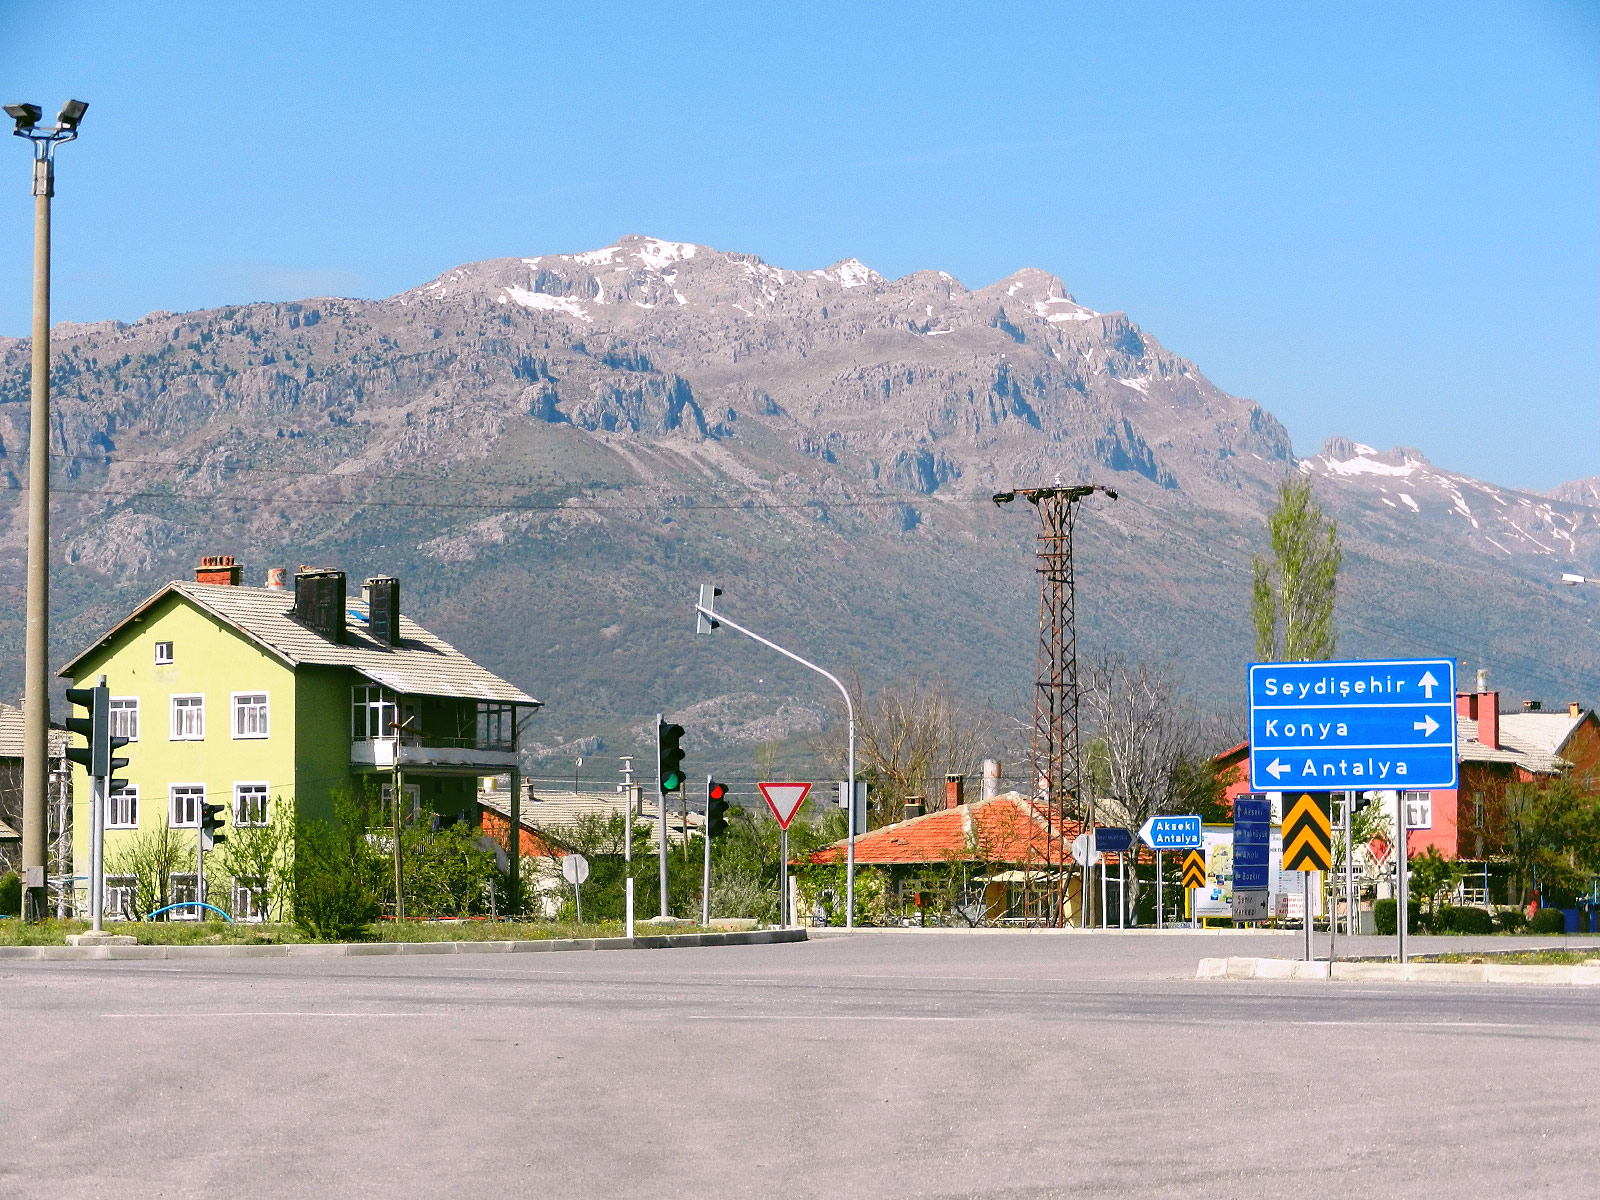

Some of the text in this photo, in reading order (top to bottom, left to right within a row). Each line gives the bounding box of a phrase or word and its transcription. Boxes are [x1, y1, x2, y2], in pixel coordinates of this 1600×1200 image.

[1264, 676, 1405, 699] Seydişehir
[1265, 719, 1348, 739] Konya
[1302, 758, 1407, 778] Antalya
[1243, 807, 1263, 816] Akseki
[1156, 821, 1195, 830] Akseki
[1156, 833, 1198, 844] Antalya
